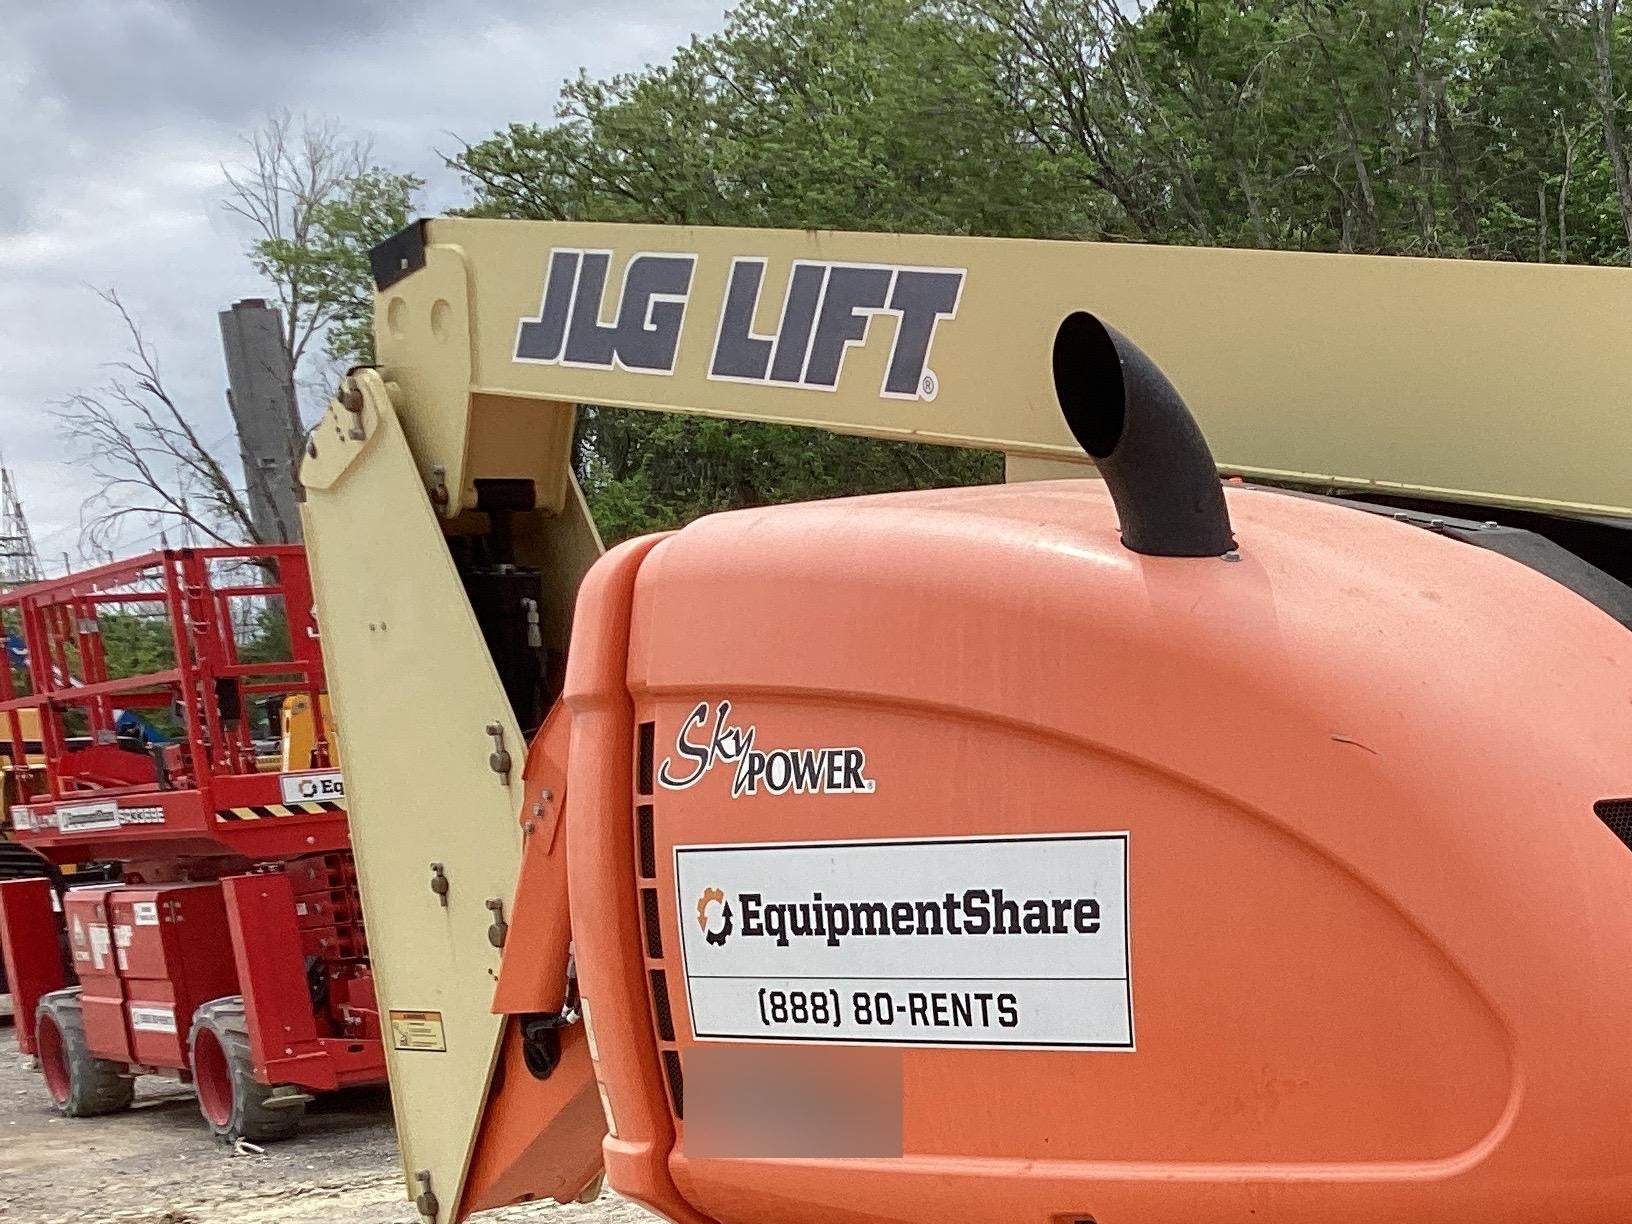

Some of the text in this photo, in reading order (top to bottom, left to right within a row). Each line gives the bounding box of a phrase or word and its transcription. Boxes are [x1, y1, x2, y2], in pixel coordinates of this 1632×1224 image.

[513, 248, 967, 400] JLG LIFT
[659, 702, 866, 797] Sky POWER
[738, 889, 1100, 947] EquipmentShare
[759, 988, 1018, 1028] (888) 80-RENTS
